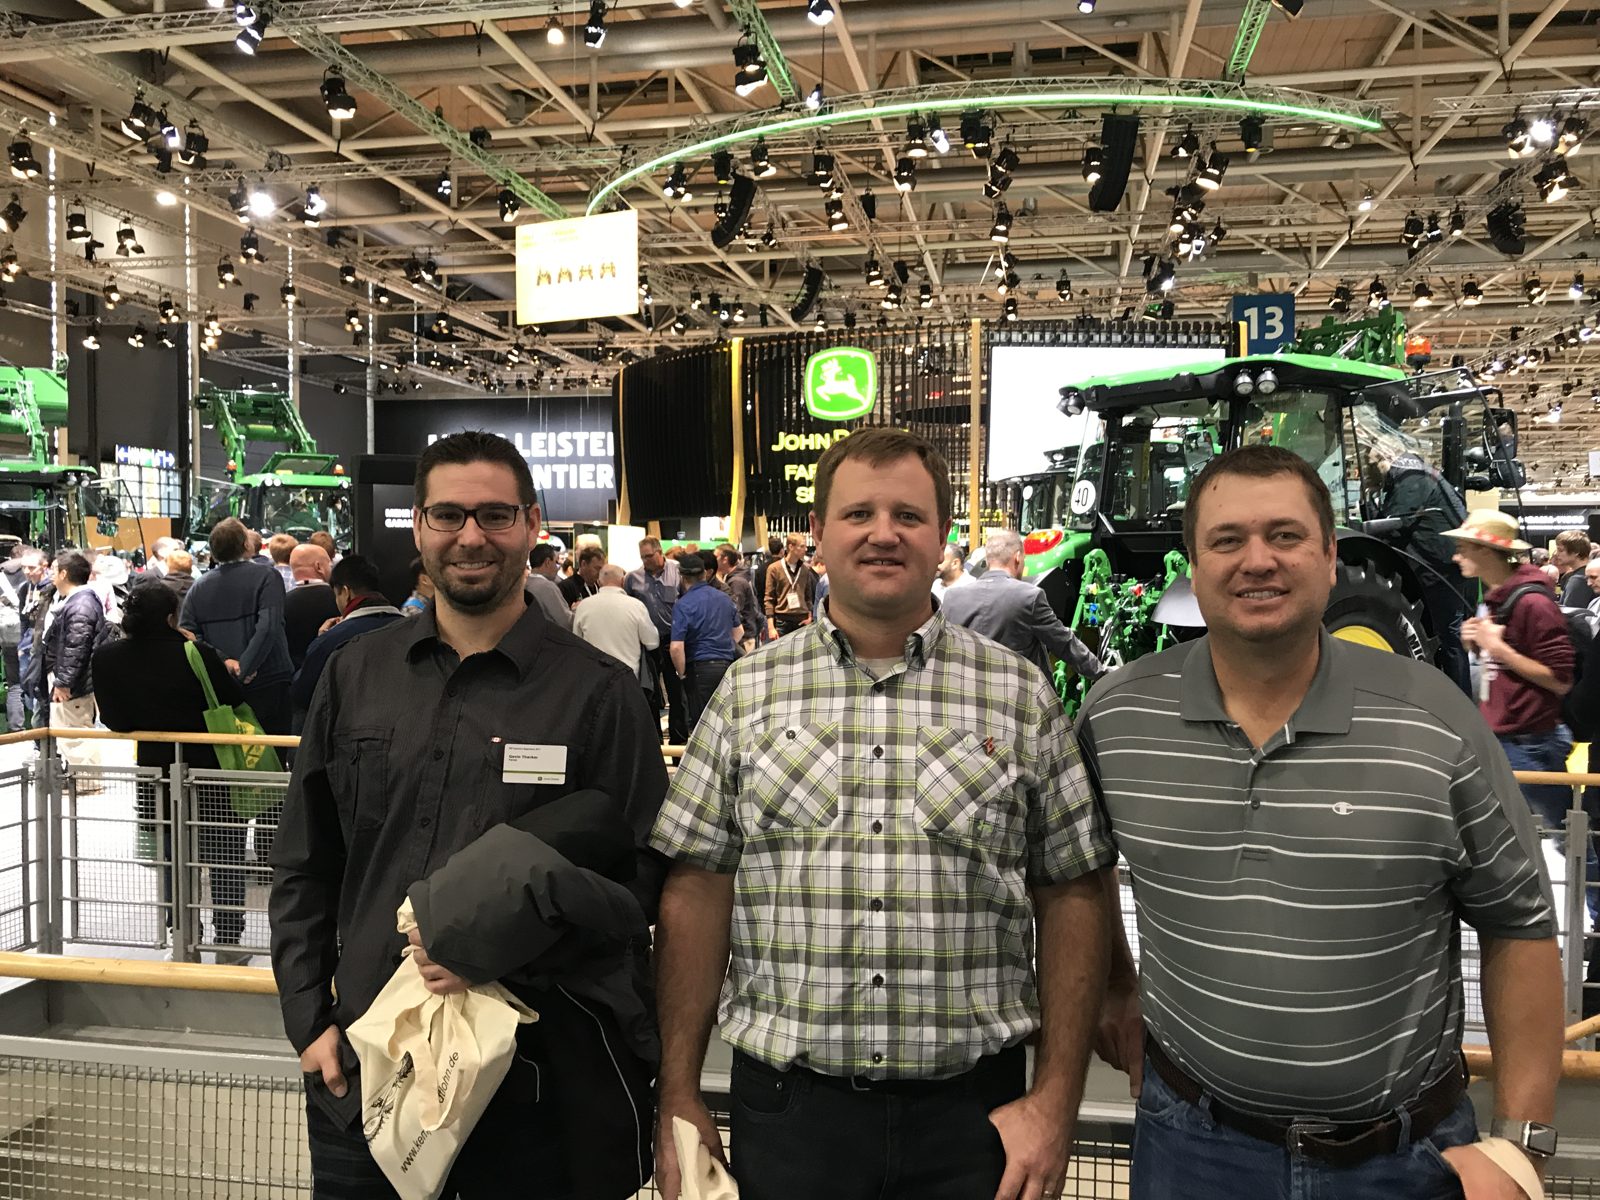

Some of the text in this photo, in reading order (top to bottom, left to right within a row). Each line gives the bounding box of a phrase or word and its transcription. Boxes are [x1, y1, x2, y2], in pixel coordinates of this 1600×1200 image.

[1243, 305, 1285, 340] 13
[771, 431, 831, 452] JOHN
[532, 463, 614, 491] NTIER
[1074, 487, 1089, 507] 40
